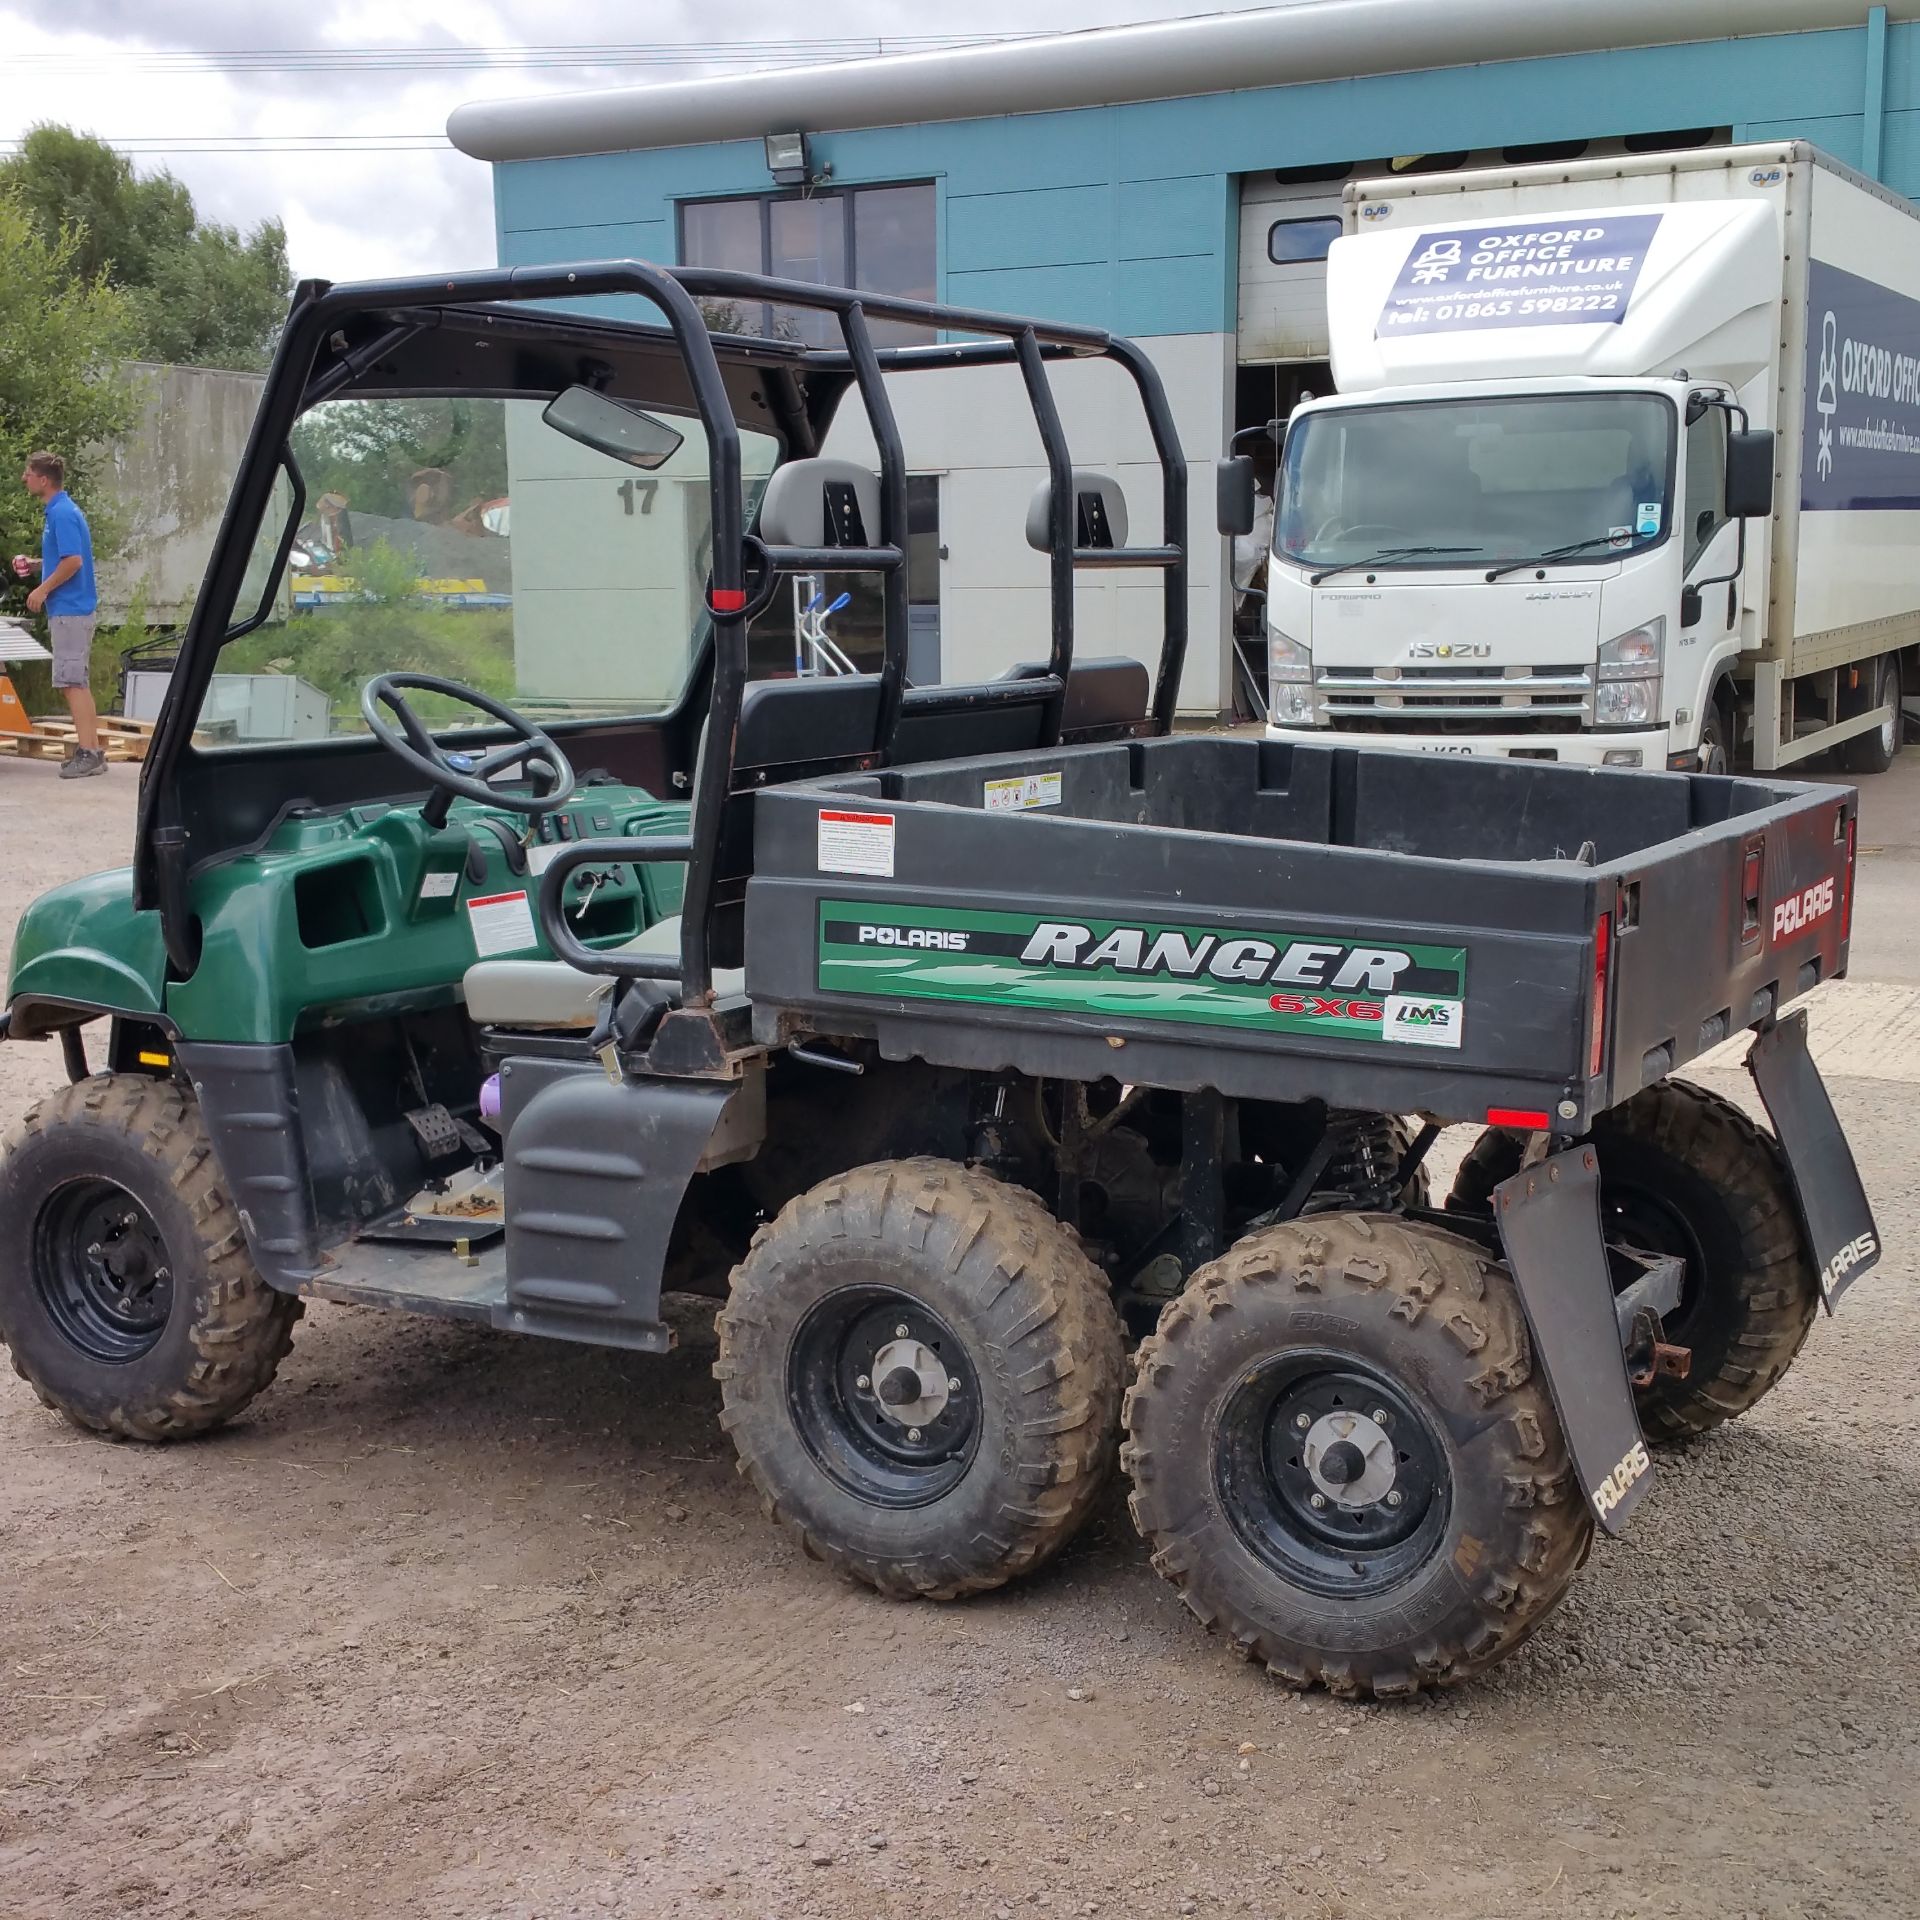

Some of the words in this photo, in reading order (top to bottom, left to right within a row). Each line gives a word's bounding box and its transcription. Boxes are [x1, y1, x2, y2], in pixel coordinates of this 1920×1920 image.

[1753, 171, 1780, 182] DJB
[1364, 206, 1388, 217] DJB
[1478, 228, 1604, 250] OXFORD
[1470, 245, 1573, 265] OFFICE
[1466, 256, 1633, 282] FURNITURE
[1395, 280, 1623, 306] www.oxfordofficefurniture.co.uk
[1388, 306, 1429, 325] tel:
[1435, 302, 1512, 321] 01865
[1518, 294, 1618, 315] 598222
[1841, 337, 1892, 399] OXFORD
[617, 479, 658, 516] 17
[1408, 642, 1491, 658] ISUZU
[1772, 877, 1835, 941] POLARIS
[858, 925, 967, 950] POLARIS
[1020, 922, 1411, 992] RANGER
[1269, 993, 1385, 1021] 6X6
[1395, 1005, 1450, 1022] LMS
[1821, 1231, 1877, 1296] OLARIS
[1591, 1440, 1650, 1521] POLARIS
